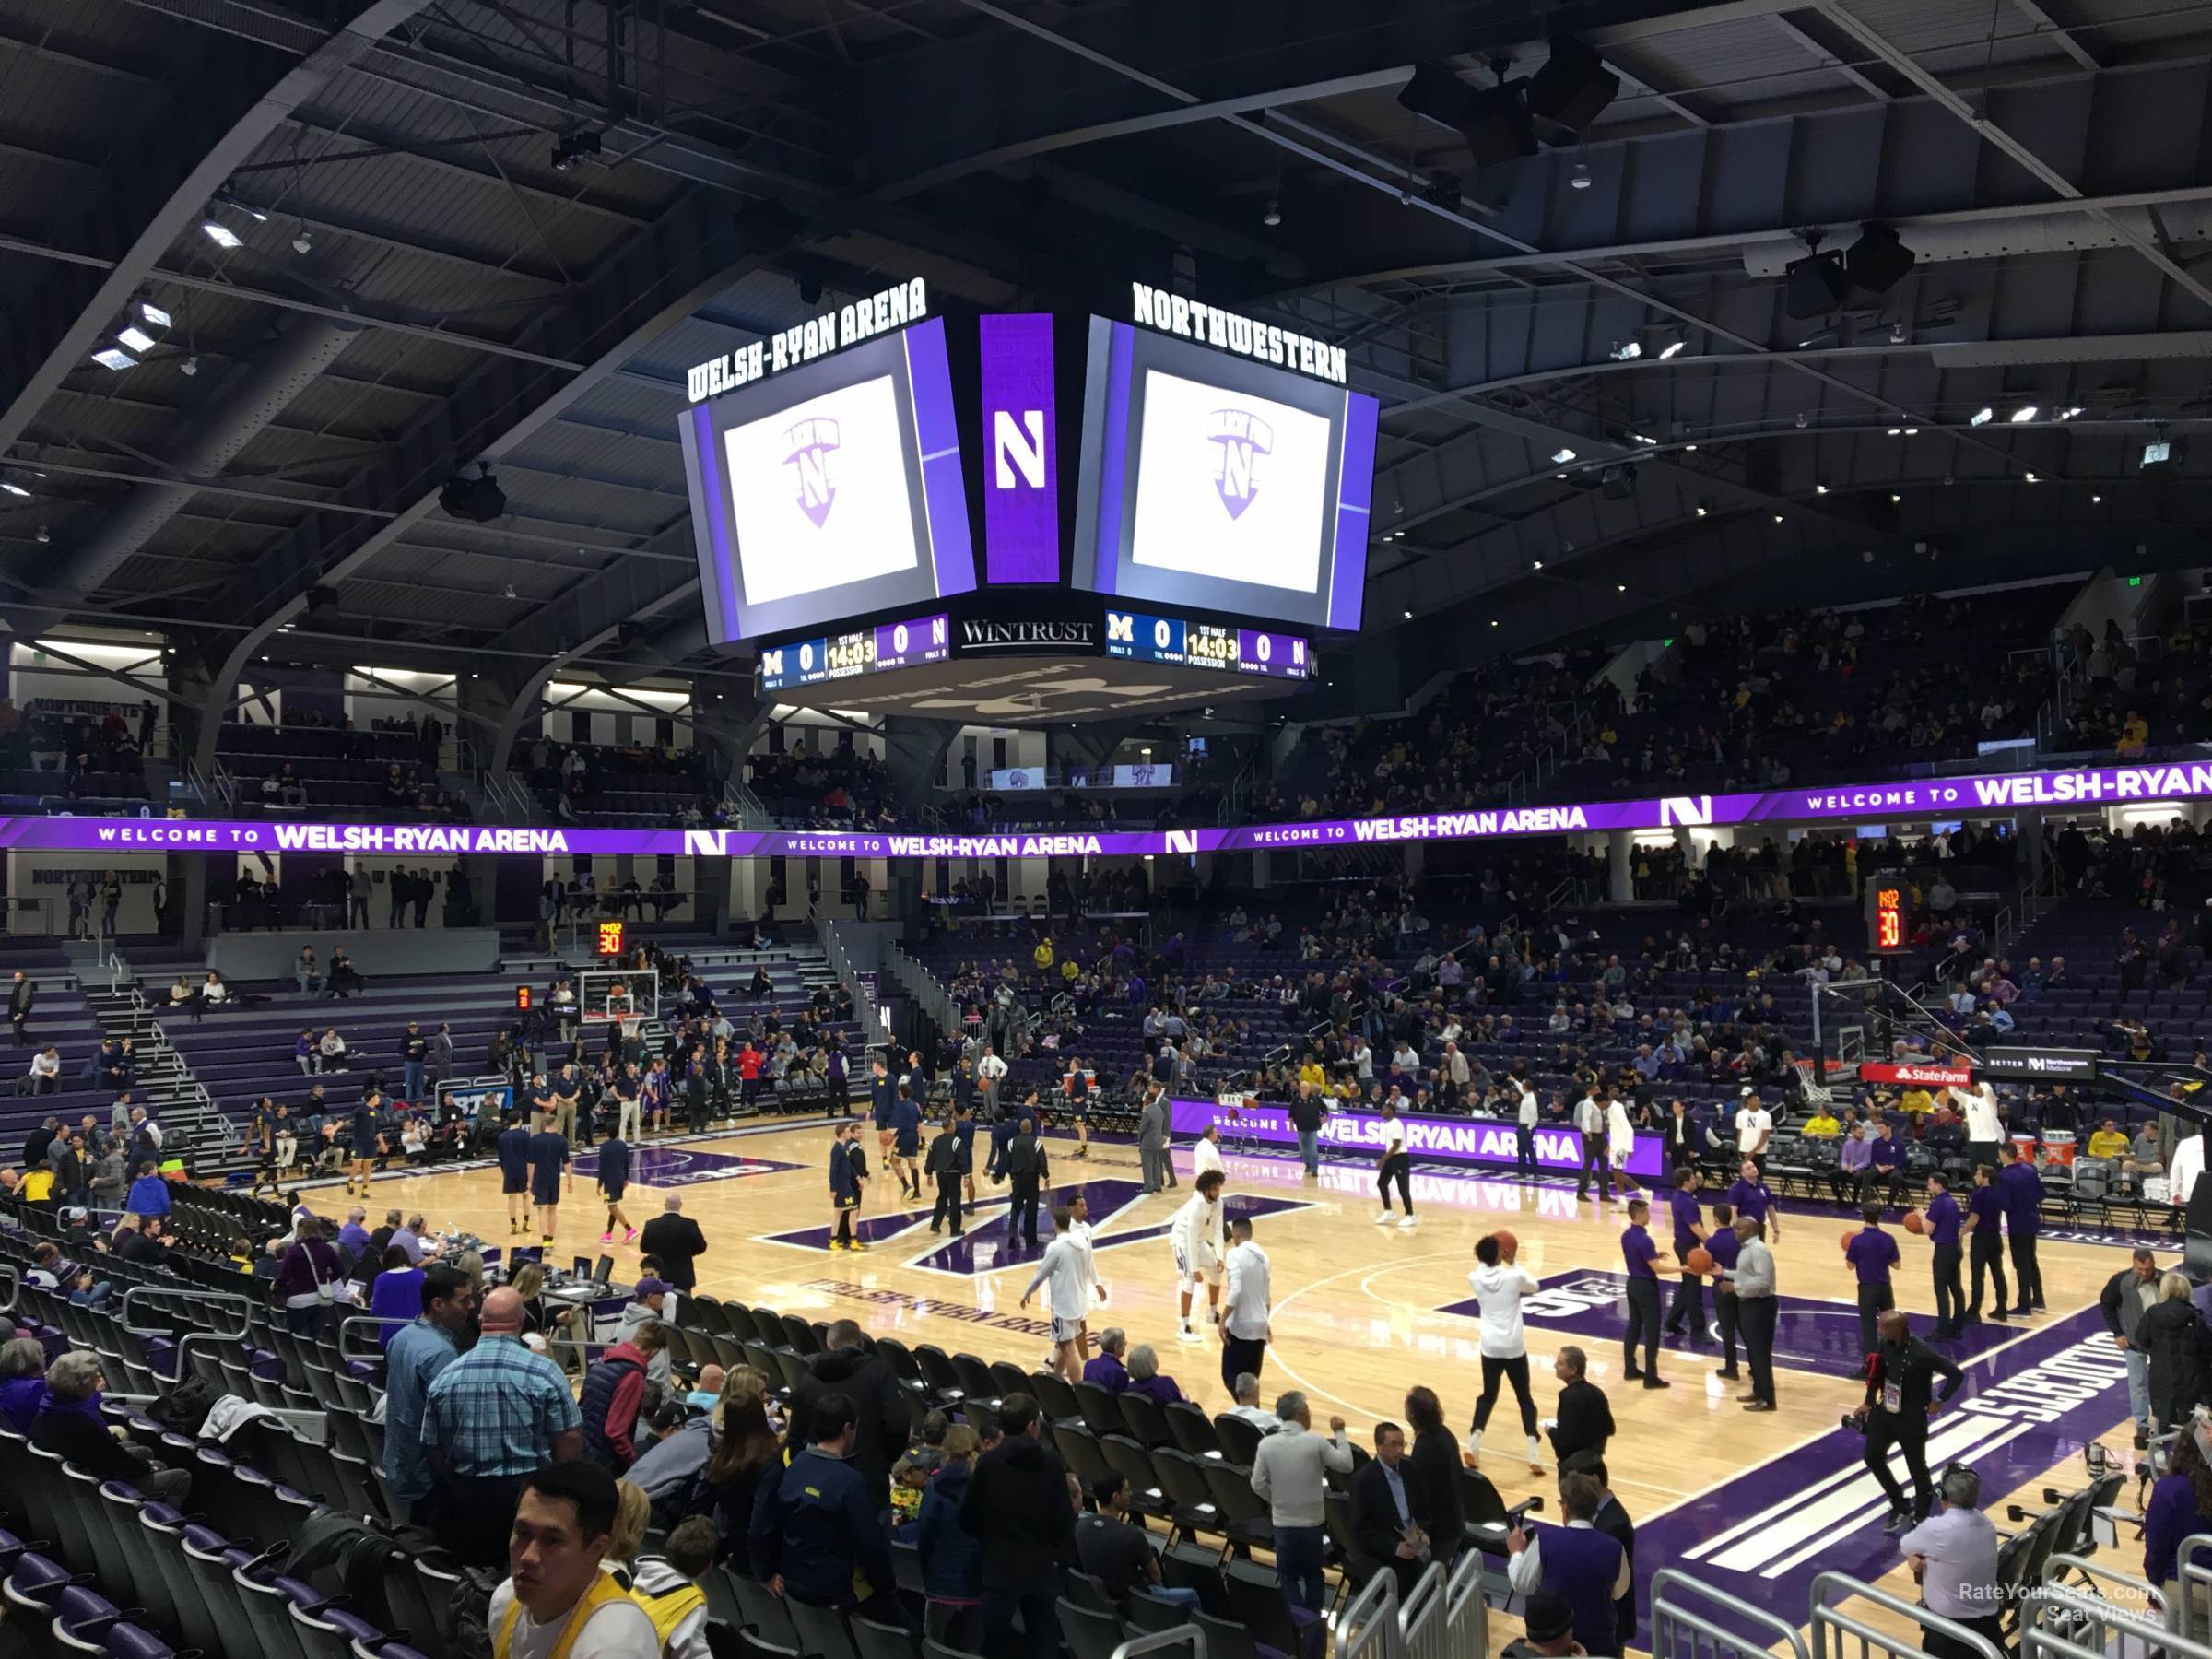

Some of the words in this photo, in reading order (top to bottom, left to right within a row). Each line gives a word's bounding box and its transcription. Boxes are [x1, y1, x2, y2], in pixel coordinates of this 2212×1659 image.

[688, 312, 836, 402] WELSH-RYAN
[841, 276, 926, 347] ARENA
[1133, 281, 1347, 383] NORTHWESTERN
[994, 410, 1045, 488] N
[838, 635, 848, 645] 1ST
[848, 632, 863, 644] HALF
[893, 624, 908, 653] 0
[933, 618, 945, 645] N
[964, 619, 1093, 642] WINTRUST
[1108, 614, 1134, 641] M
[1154, 619, 1171, 649] 0
[1200, 626, 1209, 635] 1ST
[1210, 627, 1226, 638] HALF
[799, 643, 813, 671] 0
[829, 640, 874, 668] 14:03
[1189, 634, 1237, 660] 14:03
[1256, 634, 1271, 661] 0
[1293, 641, 1304, 665] N
[762, 650, 783, 676] M
[829, 664, 863, 679] POSSESSION
[1188, 655, 1225, 669] POSSESSION
[1807, 792, 1916, 810] WELCOME
[1930, 788, 1958, 802] TO
[1975, 766, 2212, 805] WELSH-RYAN
[1253, 829, 1319, 841] WELCOME
[1327, 828, 1344, 839] TO
[1354, 813, 1497, 841] WELSH-RYAN
[1501, 806, 1587, 832] ARENA
[1660, 795, 1712, 826] N
[99, 828, 217, 842] WELCOME
[232, 830, 258, 842] TO
[274, 825, 469, 850] WELSH-RYAN
[475, 829, 568, 852] ARENA
[685, 830, 726, 855] N
[787, 840, 856, 851] WELCOME
[864, 841, 880, 851] TO
[888, 837, 1017, 855] WELSH-RYAN
[1022, 836, 1101, 855] ARENA
[1165, 830, 1197, 853] N
[1880, 911, 1898, 946] 30
[600, 934, 619, 953] 30
[1990, 1059, 2023, 1067] BETTER
